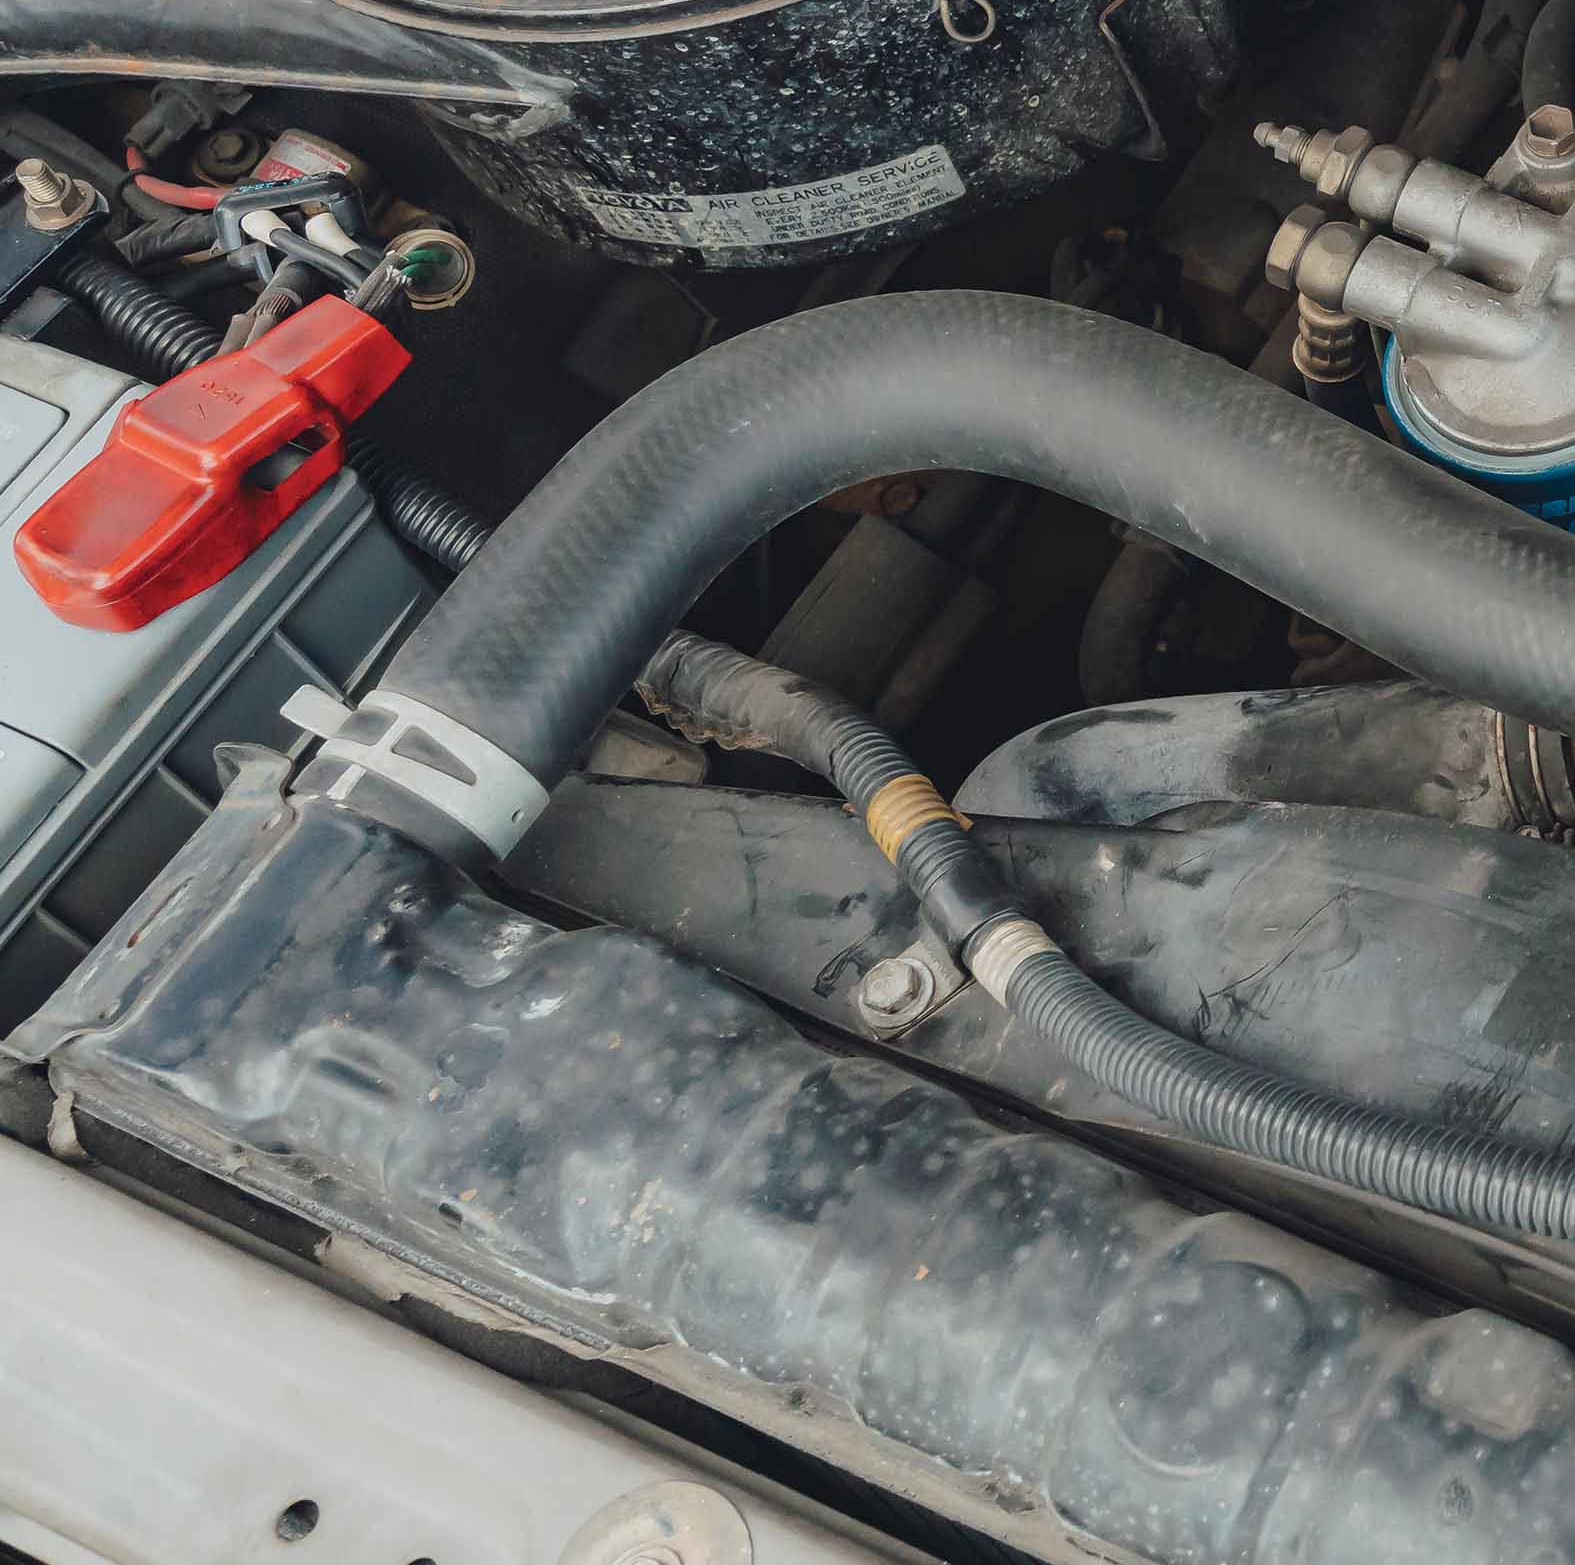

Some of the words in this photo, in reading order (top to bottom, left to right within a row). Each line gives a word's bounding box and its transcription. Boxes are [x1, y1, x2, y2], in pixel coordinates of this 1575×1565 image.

[708, 198, 739, 211] AIR
[751, 182, 848, 207] CLEANER
[857, 150, 942, 188] SERVICE
[753, 205, 800, 219] INSPECT
[810, 201, 829, 211] AIR
[834, 186, 889, 206] CLEANER
[895, 164, 946, 188] ELEMENT
[768, 231, 790, 241] FOR
[917, 189, 956, 209] MANUAL
[770, 221, 806, 233] UNDER
[849, 207, 877, 219] ROAD
